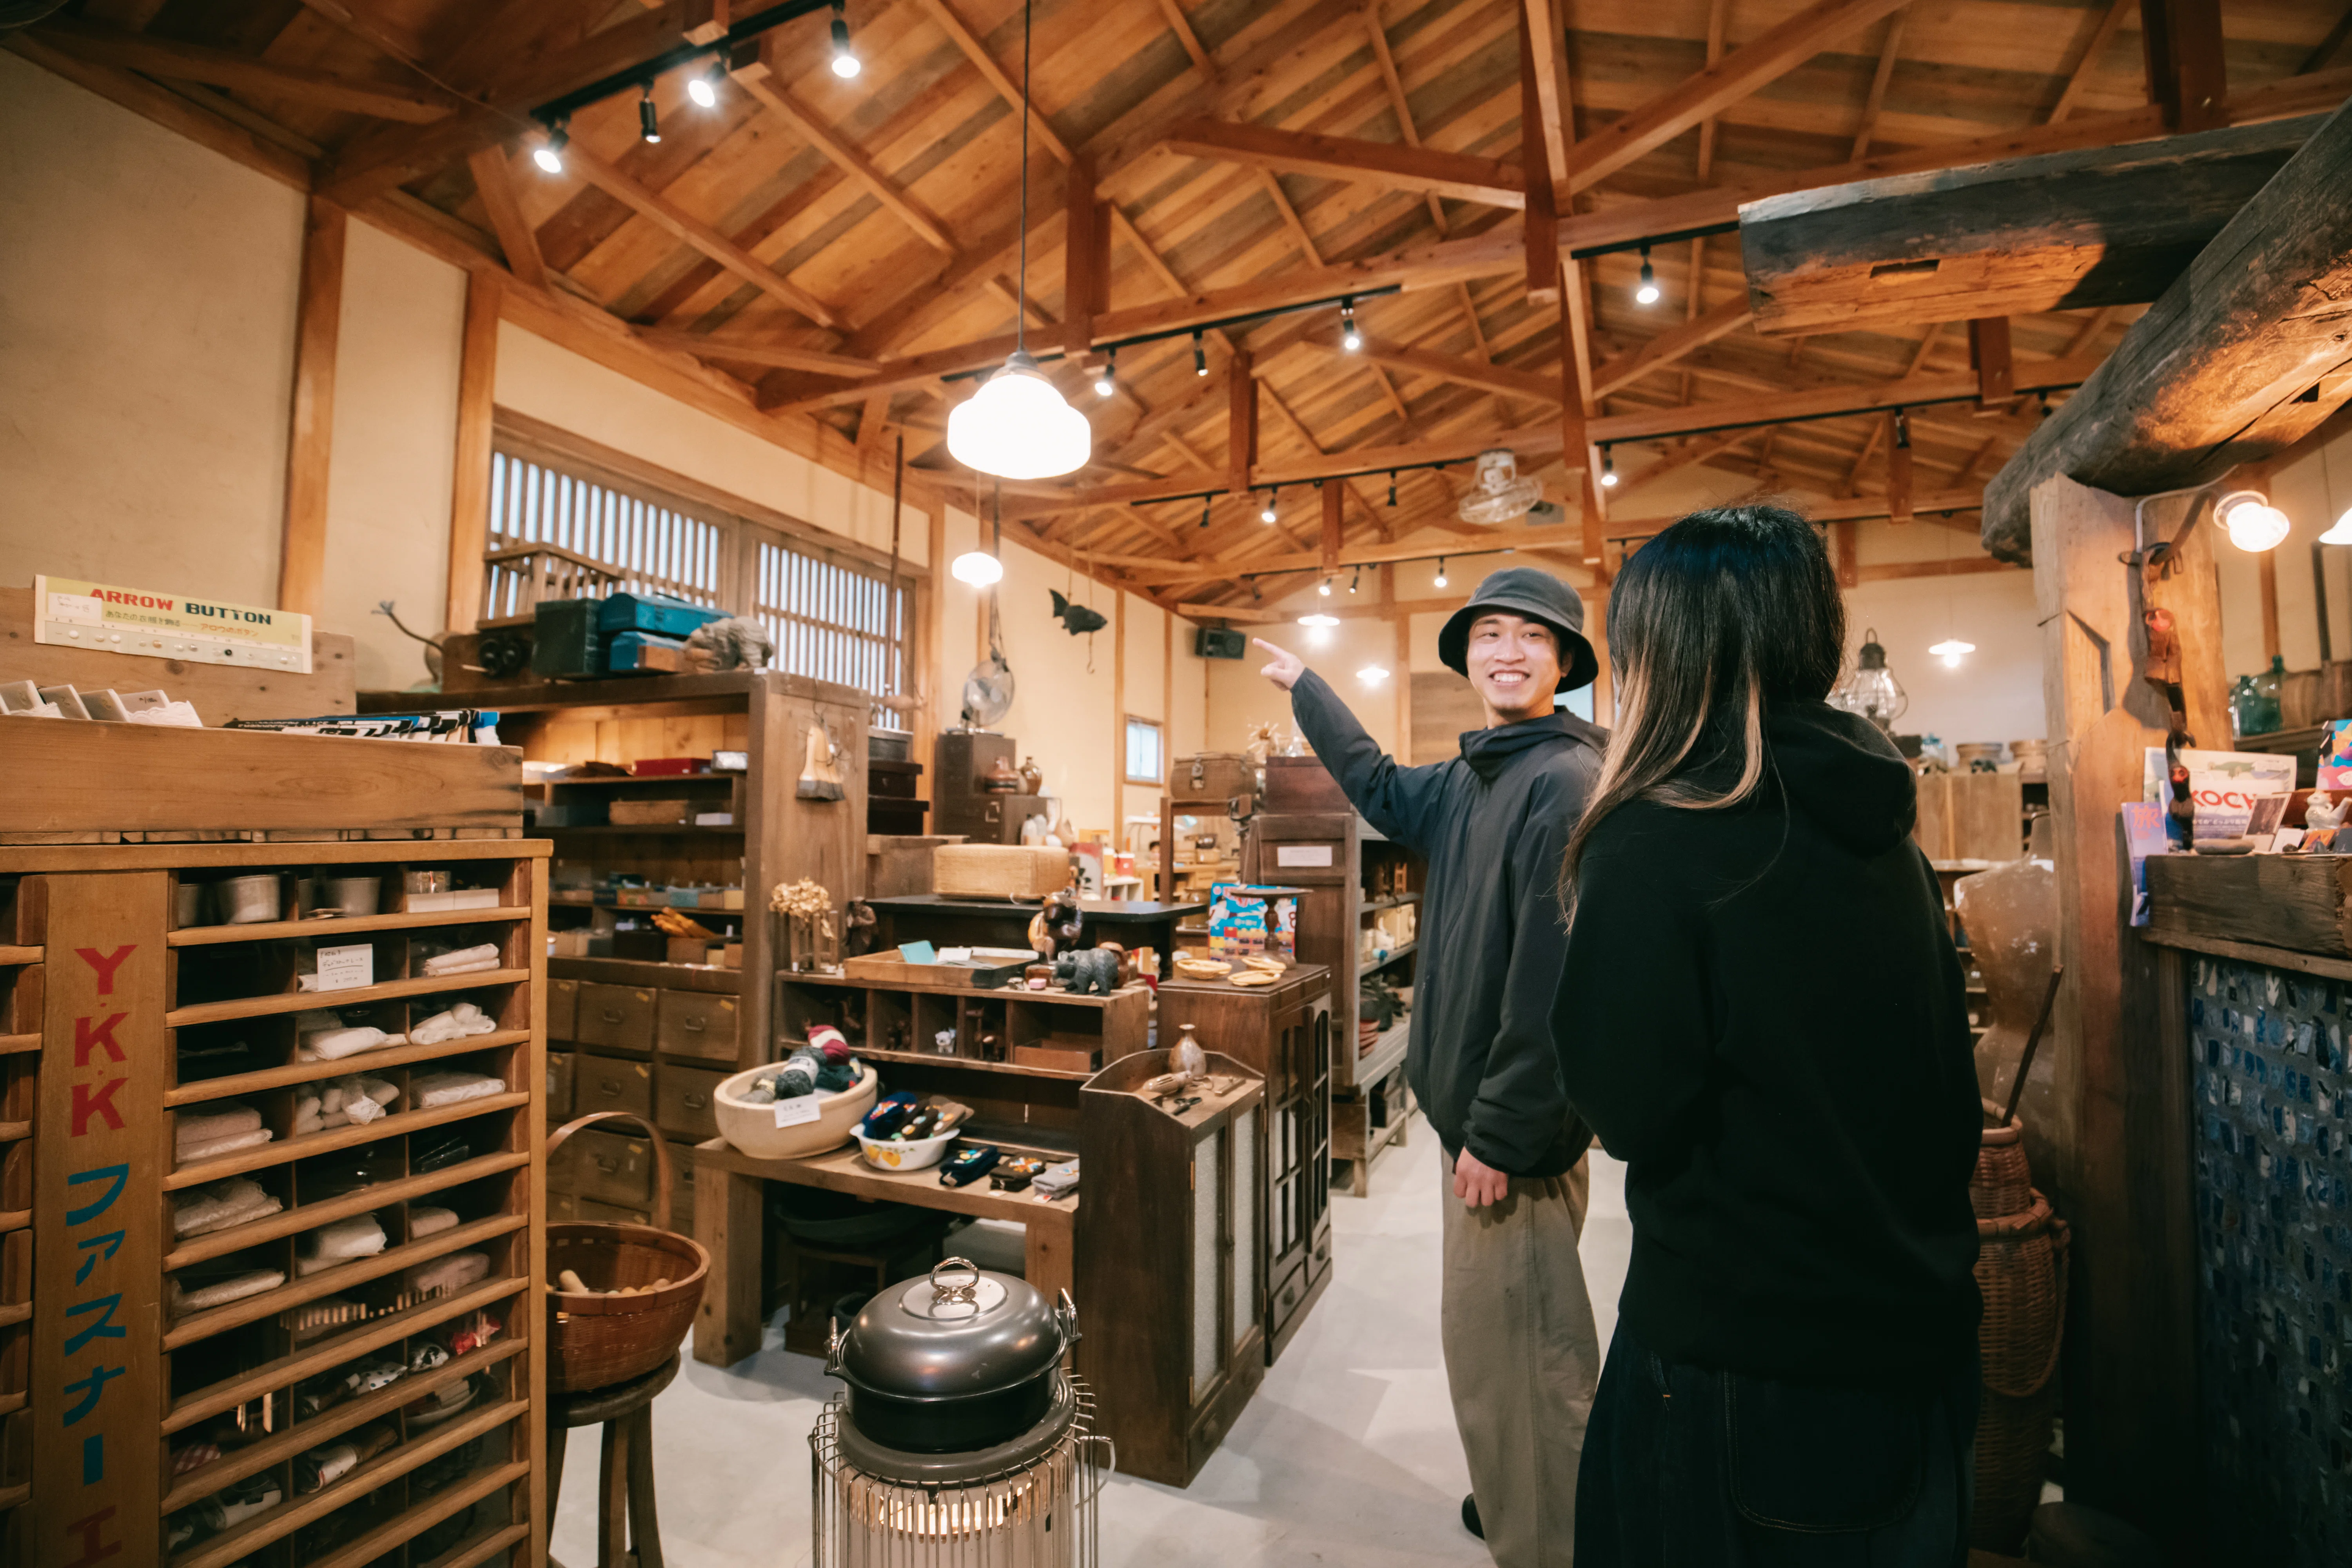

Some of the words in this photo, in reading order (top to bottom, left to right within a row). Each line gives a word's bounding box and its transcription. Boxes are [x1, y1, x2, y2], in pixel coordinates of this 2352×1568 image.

[90, 588, 173, 611] ARROW
[185, 603, 271, 625] BUTTON
[63, 1163, 130, 1486] ファスナー
